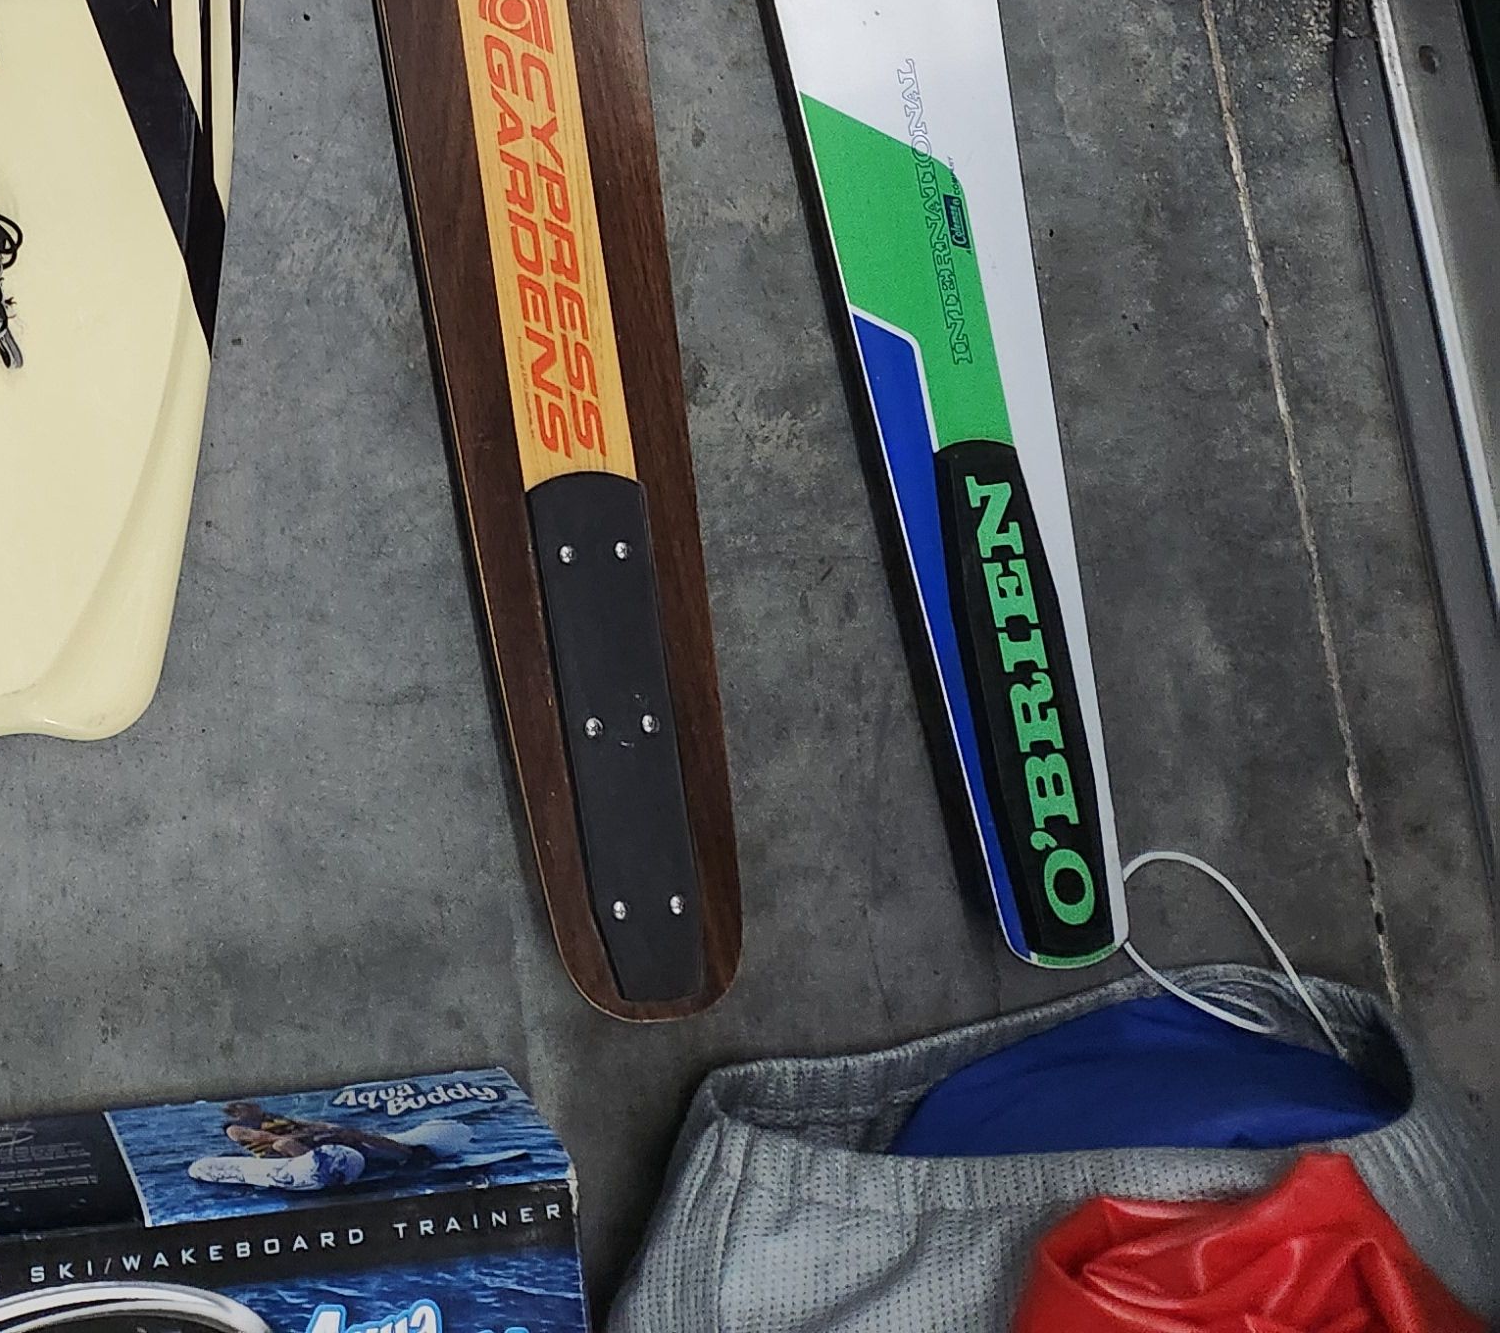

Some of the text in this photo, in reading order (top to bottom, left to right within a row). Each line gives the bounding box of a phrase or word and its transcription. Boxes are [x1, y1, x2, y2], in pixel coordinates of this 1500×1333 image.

[487, 35, 573, 460] GARDENS
[518, 53, 607, 458] CYPRESS
[896, 58, 973, 365] INTERNATIONAL
[951, 204, 967, 245] Coleman
[965, 475, 1095, 926] O'BRIEN
[333, 1082, 418, 1109] Aqua
[384, 1081, 501, 1117] Buddy
[30, 1227, 365, 1285] SKI/WAKEBOARD
[393, 1201, 562, 1241] TRAINER
